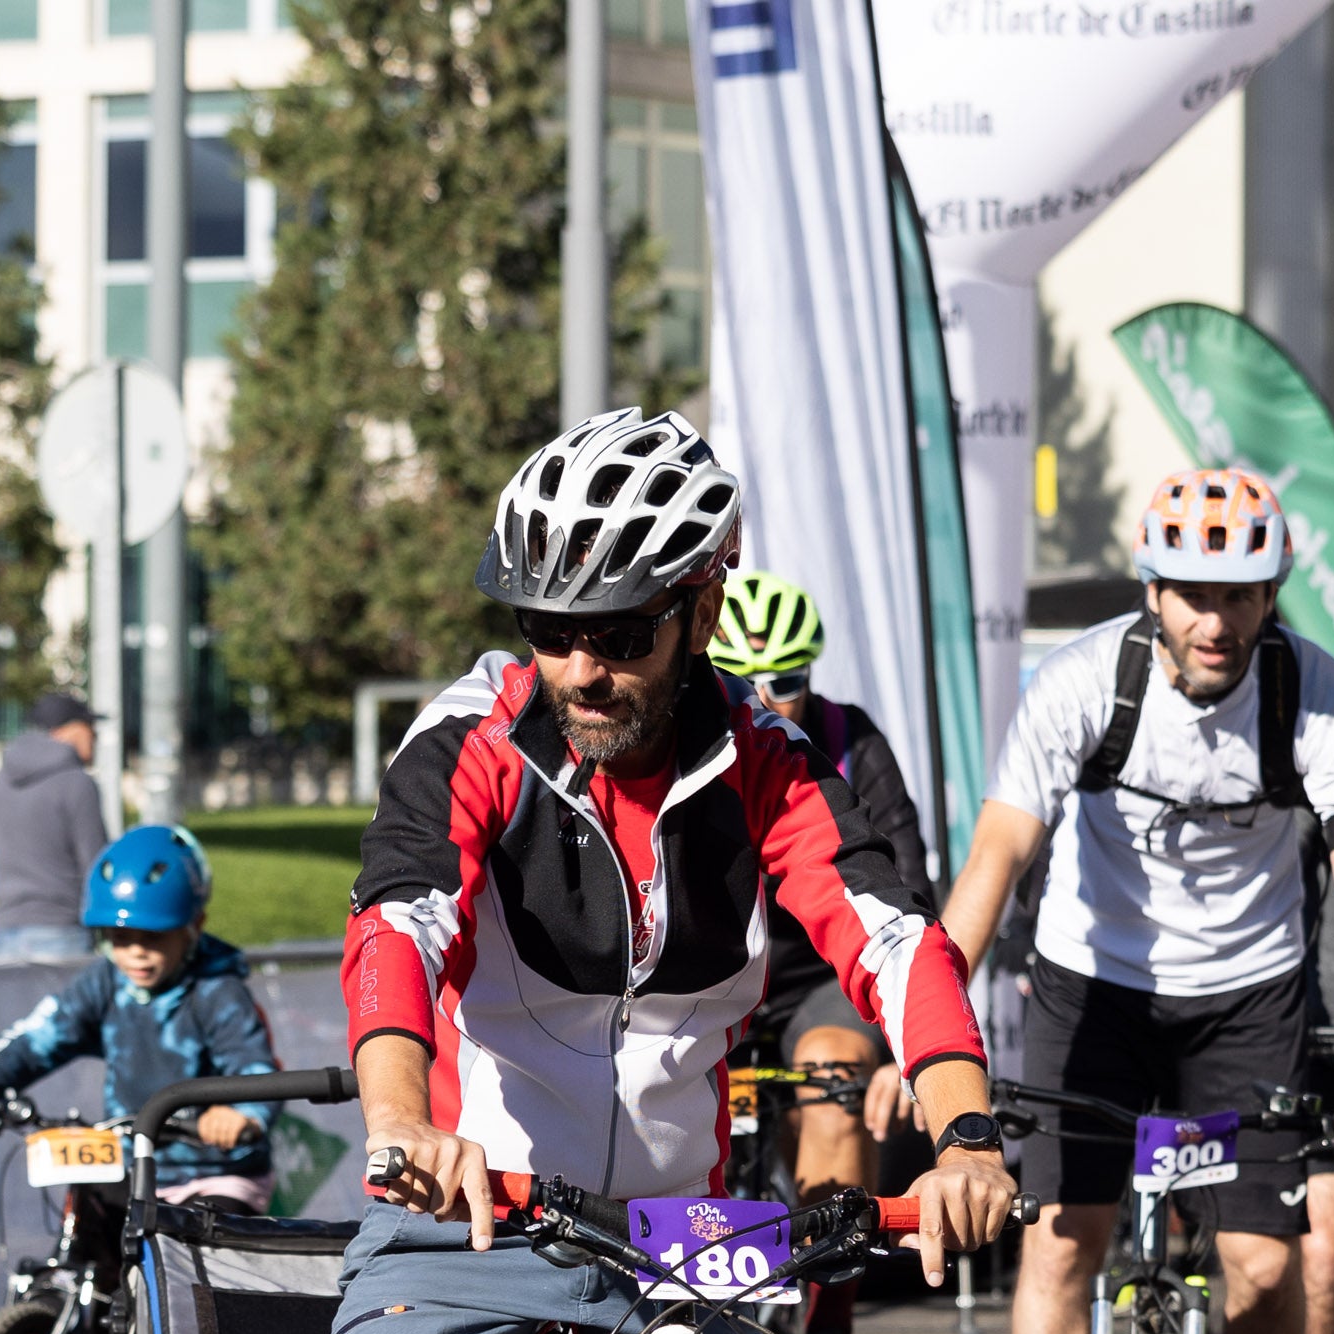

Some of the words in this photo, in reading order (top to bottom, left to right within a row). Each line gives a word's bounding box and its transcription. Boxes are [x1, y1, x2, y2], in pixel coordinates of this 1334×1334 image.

[933, 3, 971, 35] El
[981, 2, 1067, 36] Norte
[1078, 3, 1109, 37] de
[1119, 0, 1255, 38] Castilla
[886, 102, 994, 136] astilla
[978, 190, 1067, 231] Norte
[1070, 182, 1105, 211] de
[59, 1144, 117, 1166] 163
[1151, 1140, 1224, 1178] 300
[660, 1242, 771, 1287] 180
